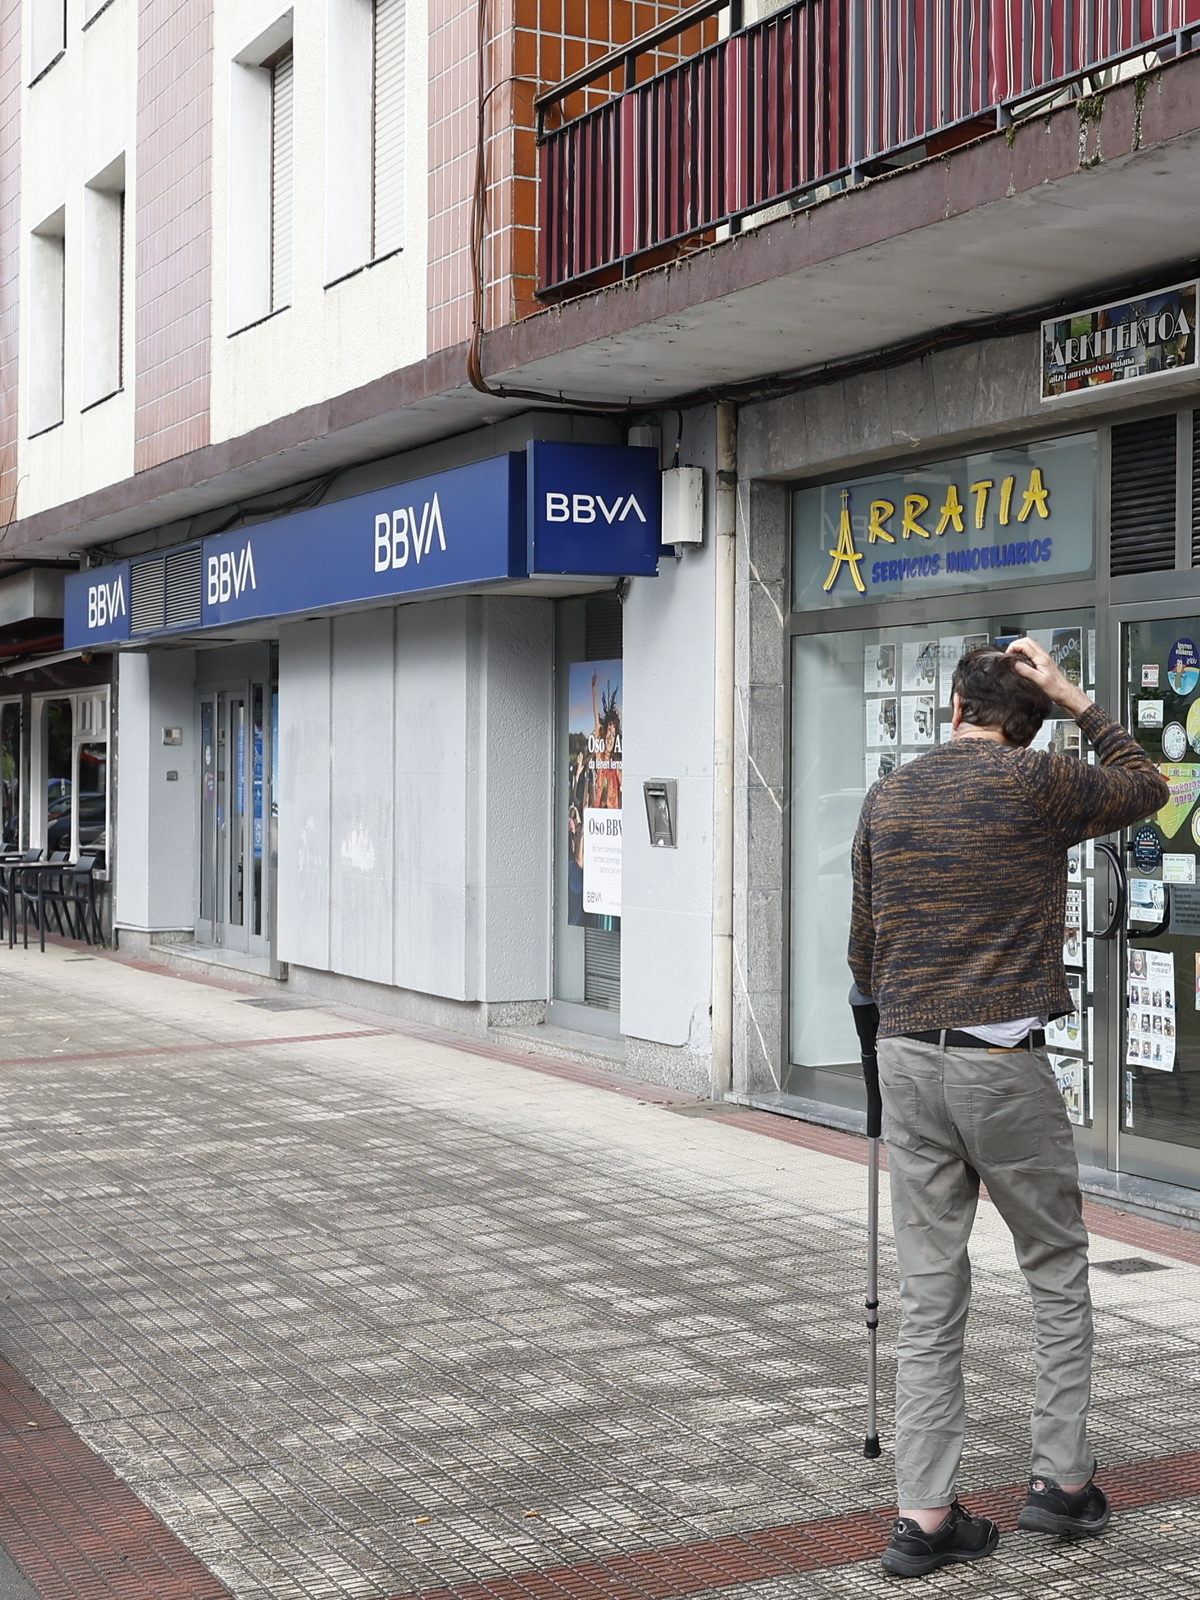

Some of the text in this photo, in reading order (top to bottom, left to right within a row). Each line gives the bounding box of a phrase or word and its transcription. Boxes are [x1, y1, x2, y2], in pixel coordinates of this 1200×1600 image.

[1049, 307, 1191, 368] ARKITEKTOA
[1110, 356, 1135, 370] pujana
[546, 492, 647, 525] BBVA
[374, 491, 447, 573] BBVA
[822, 467, 1050, 594] ARRATIA
[207, 540, 257, 606] BBVA
[871, 537, 1052, 584] SERVICIOS INMOBILIARIOS
[88, 574, 126, 629] BBVA
[588, 734, 605, 754] Oso
[588, 758, 595, 769] da
[588, 817, 623, 837] Oso BBV
[586, 891, 603, 904] BBVA
